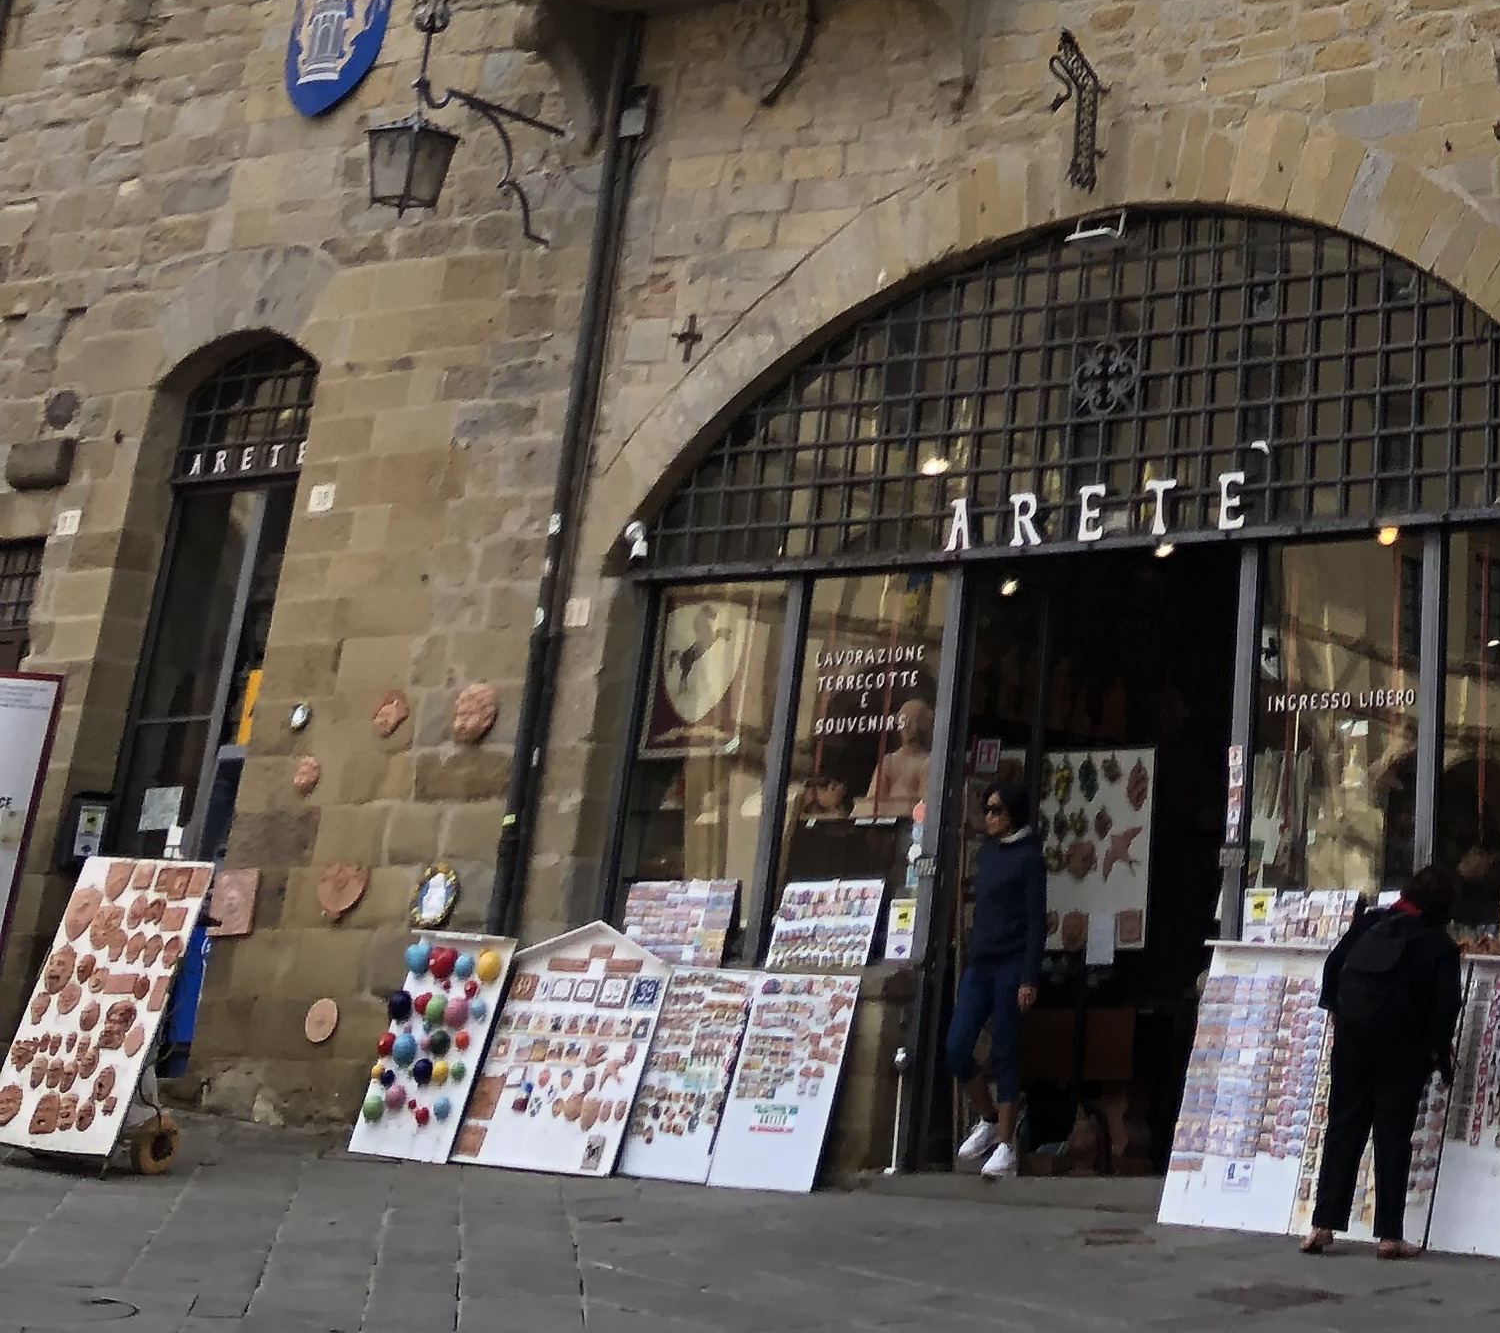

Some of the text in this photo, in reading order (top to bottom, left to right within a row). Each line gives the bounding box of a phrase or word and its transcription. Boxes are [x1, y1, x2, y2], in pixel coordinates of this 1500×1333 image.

[815, 644, 925, 668] LAVORAZIONE
[817, 670, 919, 693] TERRECOTTE
[860, 691, 869, 709] E
[1267, 688, 1415, 713] INGRESSO LIBERO
[814, 714, 906, 735] SOUVENIRS
